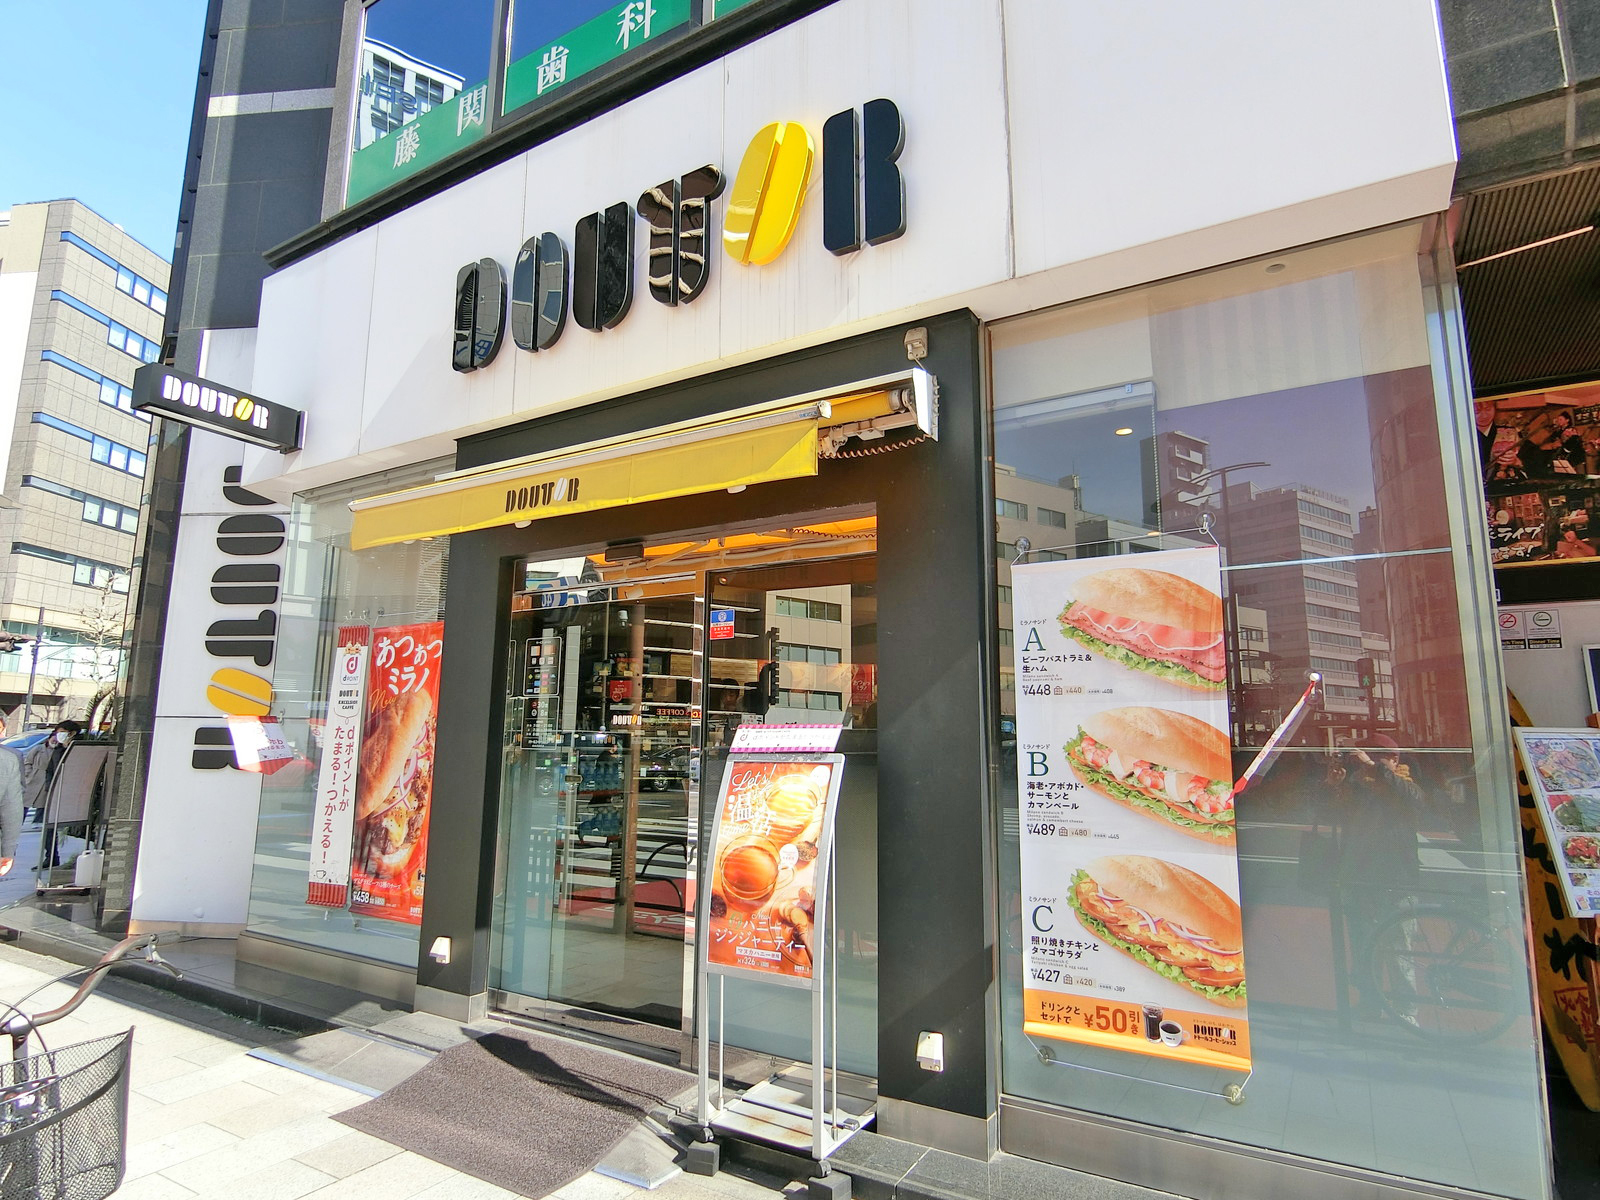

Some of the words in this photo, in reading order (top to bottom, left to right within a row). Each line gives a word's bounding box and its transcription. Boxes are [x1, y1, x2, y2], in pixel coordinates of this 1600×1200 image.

[452, 98, 906, 374] DOUTOR
[162, 374, 269, 430] DOUTOR
[505, 477, 579, 513] DOUTOR
[1021, 627, 1046, 652] A
[1022, 664, 1048, 674] 生ハム
[388, 666, 430, 695] ミラノ
[1023, 683, 1051, 696] ¥448
[337, 725, 356, 812] dポイントが
[1026, 751, 1049, 777] B
[1027, 791, 1070, 801] サーモンと
[1027, 801, 1080, 811] カマンベール
[1027, 823, 1056, 836] ¥489
[742, 919, 783, 934] ハニー
[1032, 905, 1054, 933] C
[714, 927, 806, 953] ジンジャーティー
[1031, 936, 1100, 952] 照り焼きチキンと
[1031, 946, 1083, 960] タマゴサラダ
[1031, 968, 1060, 983] ¥427
[1040, 1001, 1081, 1016] ドリンクと
[1040, 1012, 1072, 1025] セットで
[1083, 1005, 1128, 1034] ¥50
[1128, 1010, 1141, 1036] 引き
[1193, 1024, 1237, 1041] DOUTOR
